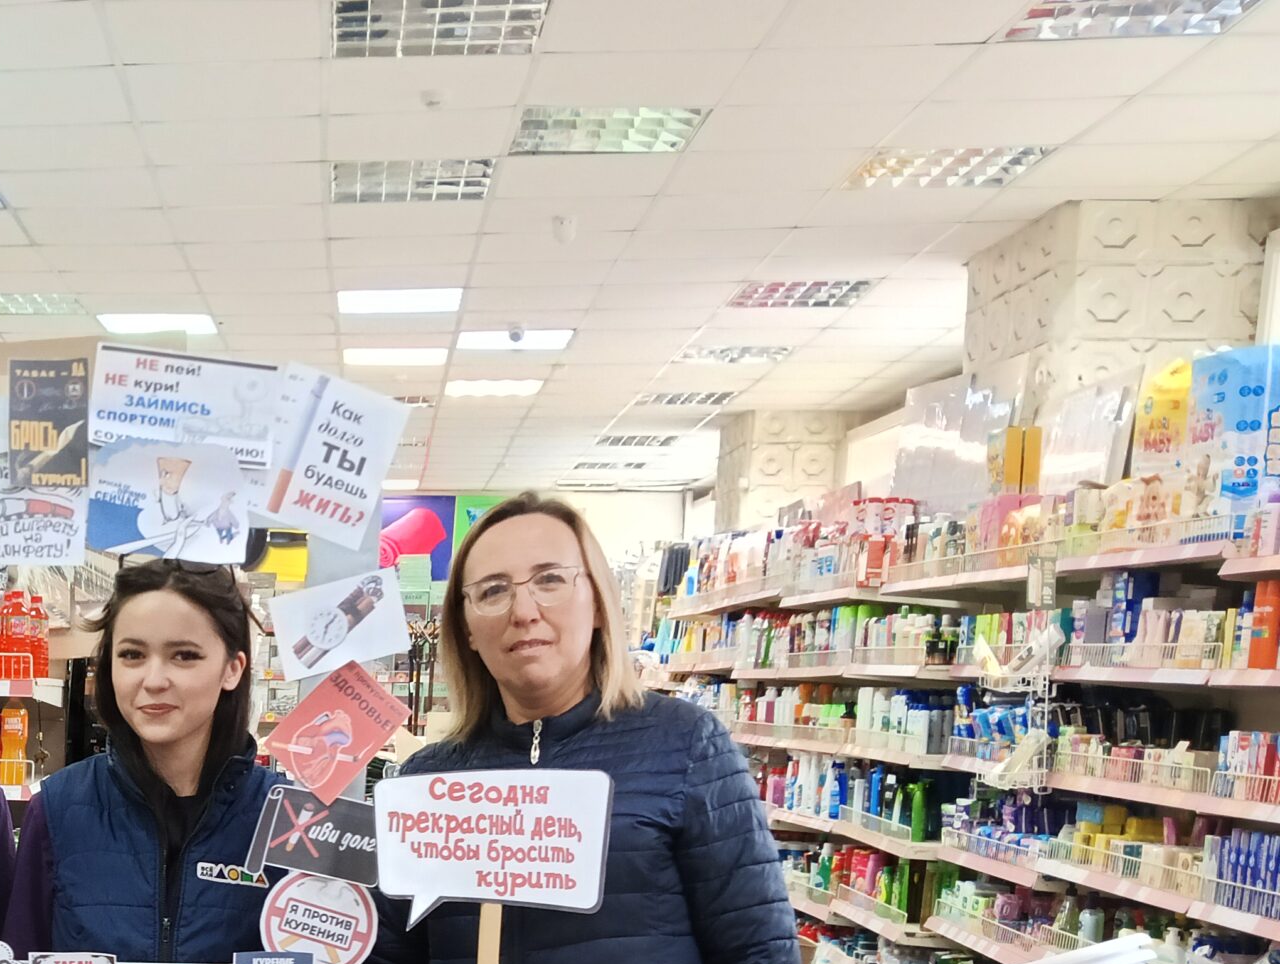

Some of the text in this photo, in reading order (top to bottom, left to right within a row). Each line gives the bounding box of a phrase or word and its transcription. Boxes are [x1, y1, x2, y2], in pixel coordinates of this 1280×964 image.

[135, 357, 202, 377] НЕ пей!
[104, 373, 180, 393] НЕ кури!
[124, 393, 211, 416] ЗАЙМИСЬ
[330, 400, 365, 425] Как
[96, 409, 176, 429] СПОРТОМ!
[10, 420, 58, 451] БРОСЬ
[318, 420, 365, 448] долго
[322, 442, 367, 476] ТЫ
[304, 464, 368, 500] будешь
[292, 489, 365, 527] ЖИТЬ?
[329, 672, 396, 732] ЗДОРОВЬЕ!
[428, 777, 550, 806] Сегодня
[387, 809, 582, 843] прекрасный день,
[338, 832, 376, 852] долг
[410, 839, 575, 870] чтобы бросить
[475, 870, 577, 897] курить
[283, 917, 350, 946] КУРЕНИЯ!
[288, 906, 353, 932] Я ПРОТИВ
